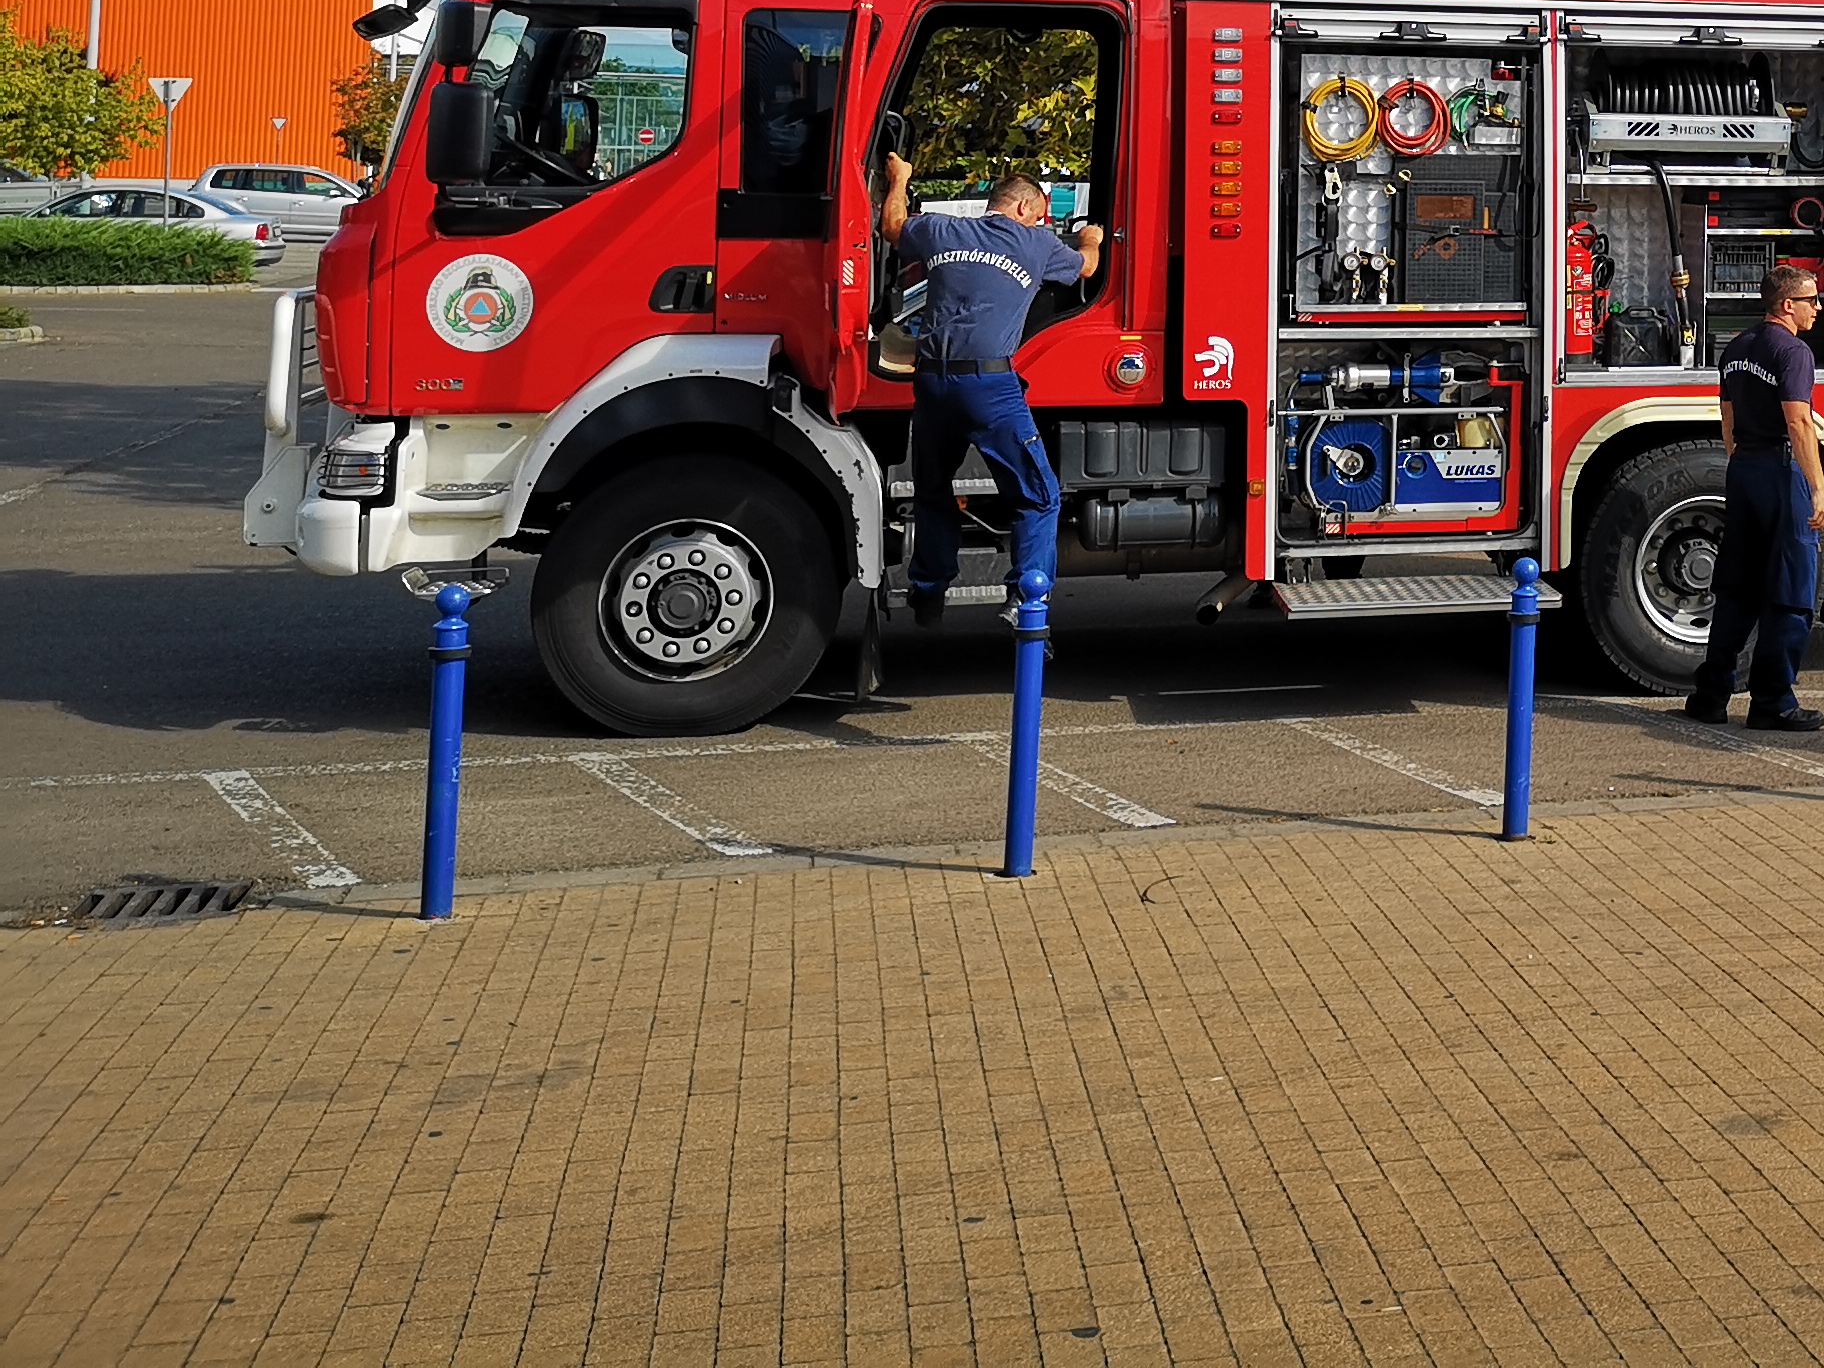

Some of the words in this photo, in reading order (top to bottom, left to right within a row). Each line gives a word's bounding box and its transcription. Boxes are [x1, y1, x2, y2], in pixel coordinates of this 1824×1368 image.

[1679, 125, 1716, 135] HEROS
[1193, 379, 1232, 390] HEROS
[1445, 464, 1497, 477] LUKAS
